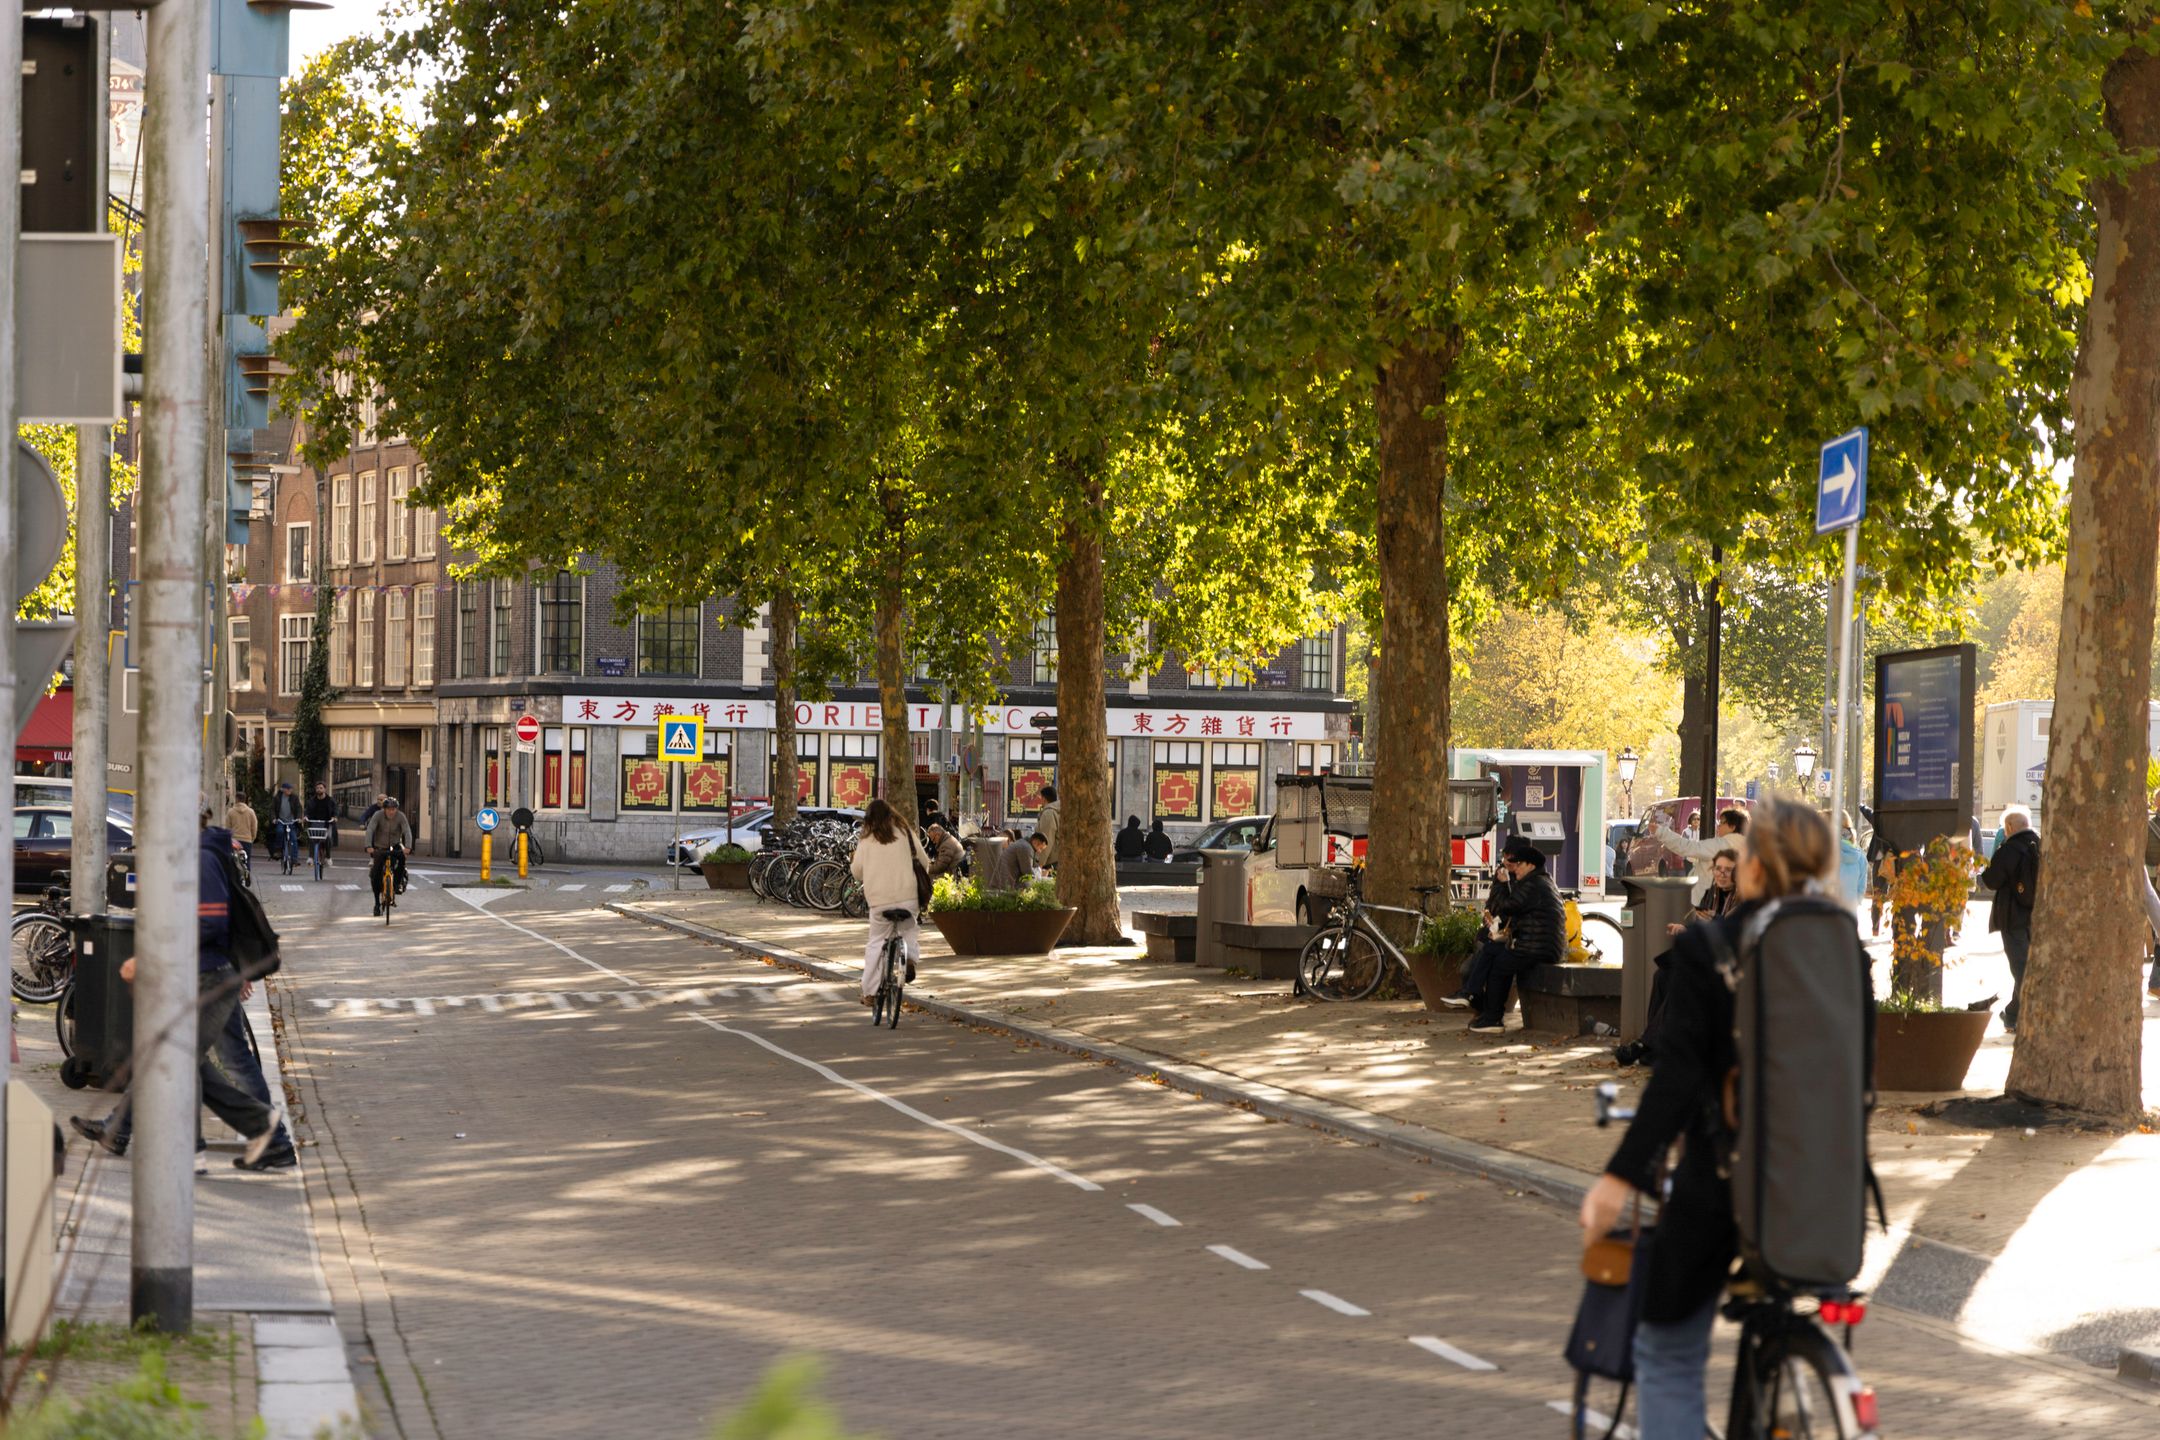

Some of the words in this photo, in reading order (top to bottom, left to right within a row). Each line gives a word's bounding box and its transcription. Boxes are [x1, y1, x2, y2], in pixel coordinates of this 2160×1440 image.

[1132, 712, 1293, 737] 東方雜貨行
[636, 772, 658, 793] 品
[694, 771, 718, 796] 食
[841, 776, 865, 797] 東
[1164, 784, 1190, 803] 工
[1223, 782, 1247, 808] 艺
